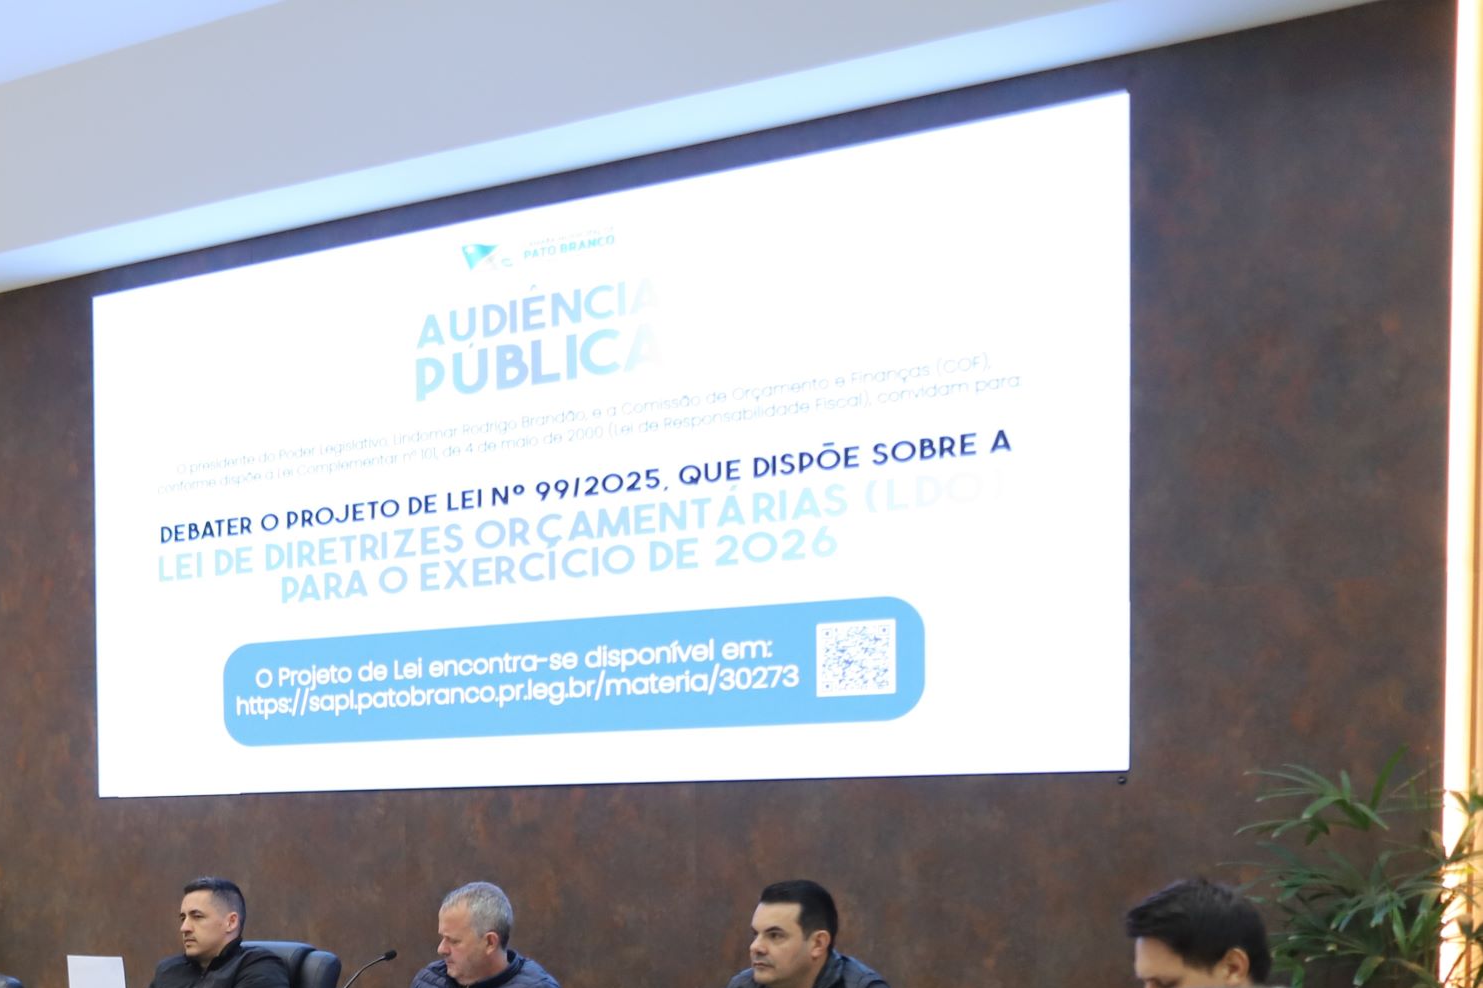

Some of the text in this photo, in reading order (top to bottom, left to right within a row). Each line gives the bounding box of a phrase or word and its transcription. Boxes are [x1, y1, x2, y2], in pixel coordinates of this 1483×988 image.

[522, 244, 557, 260] PATO
[558, 233, 615, 254] BRANCO
[415, 279, 654, 350] AUDIÊNCIA
[413, 315, 656, 404] PÚBLICA
[156, 477, 217, 496] conforme
[219, 470, 263, 487] dispõe
[264, 467, 274, 481] a
[276, 464, 294, 480] Lei
[295, 451, 399, 477] Complementar
[441, 443, 462, 459] de
[463, 441, 475, 457] 4
[476, 438, 498, 457] de
[500, 433, 540, 450] maio
[541, 430, 564, 447] de
[566, 424, 604, 444] 2000
[607, 420, 634, 439] (Lei
[637, 418, 660, 433] de
[663, 399, 812, 433] Responsabilidade
[876, 379, 971, 404] convidam
[974, 374, 1023, 394] para
[188, 452, 256, 476] presidente
[257, 447, 276, 465] do
[277, 445, 317, 464] Poder
[391, 423, 460, 450] Lindomar
[461, 417, 519, 437] Rodrigo
[591, 406, 603, 420] e
[605, 404, 618, 418] a
[620, 391, 702, 416] Comissão
[704, 389, 728, 407] de
[731, 375, 833, 402] Orçamento
[833, 375, 846, 389] e
[849, 359, 932, 385] Finanças
[159, 515, 253, 545] DEBATER
[259, 511, 280, 533] O
[285, 497, 401, 531] PROJETO
[407, 492, 438, 517] DE
[445, 487, 483, 513] LEI
[533, 467, 669, 502] 99/2025,
[677, 457, 742, 487] QUE
[871, 431, 978, 467] SOBRE
[989, 428, 1013, 454] A
[157, 550, 203, 583] LEI
[213, 545, 254, 577] DE
[264, 522, 464, 572] DIRETRIZES
[473, 482, 848, 550] ORÇAMENTÁRIAS
[280, 524, 838, 605] PARA O EXERCÍCIO DE 2026
[236, 664, 798, 719] https://sapl.patobranco.pr.leg.br/materia/30273
[255, 639, 771, 693] O Projeto de Lei encontra-se disponível em:
